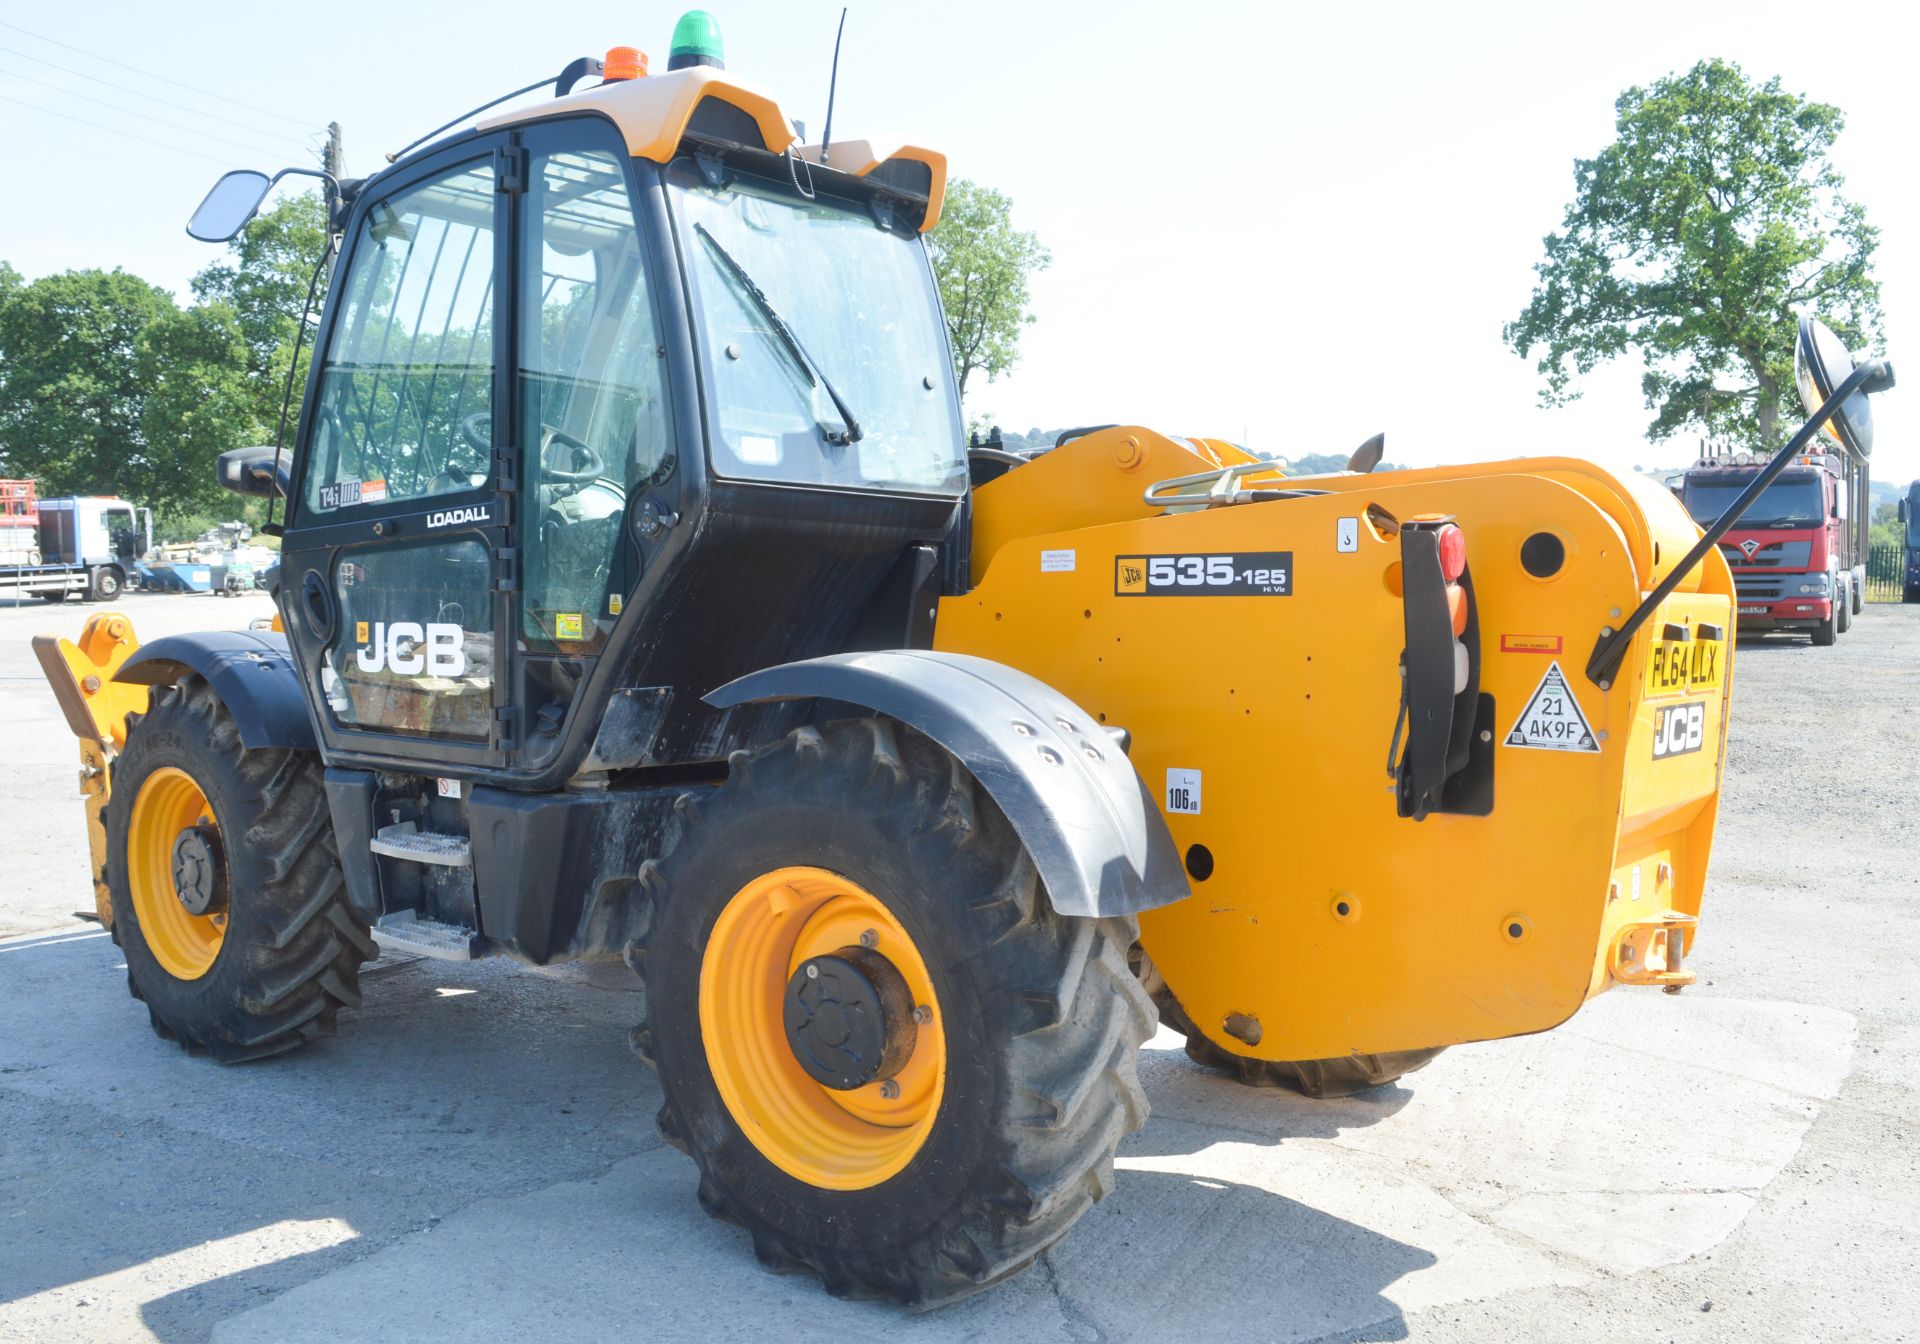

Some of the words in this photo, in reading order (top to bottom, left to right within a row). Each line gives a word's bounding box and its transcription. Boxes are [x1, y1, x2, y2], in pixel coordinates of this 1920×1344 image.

[320, 486, 340, 507] T4i
[426, 505, 490, 528] LOADALL
[1125, 566, 1143, 585] JCB
[356, 621, 465, 677] JCB
[1652, 646, 1688, 688] FL64
[1691, 645, 1717, 684] LLX
[1541, 697, 1564, 716] 21
[1529, 719, 1578, 739] AK9F
[1653, 705, 1704, 756] JCB
[1169, 788, 1189, 810] 106
